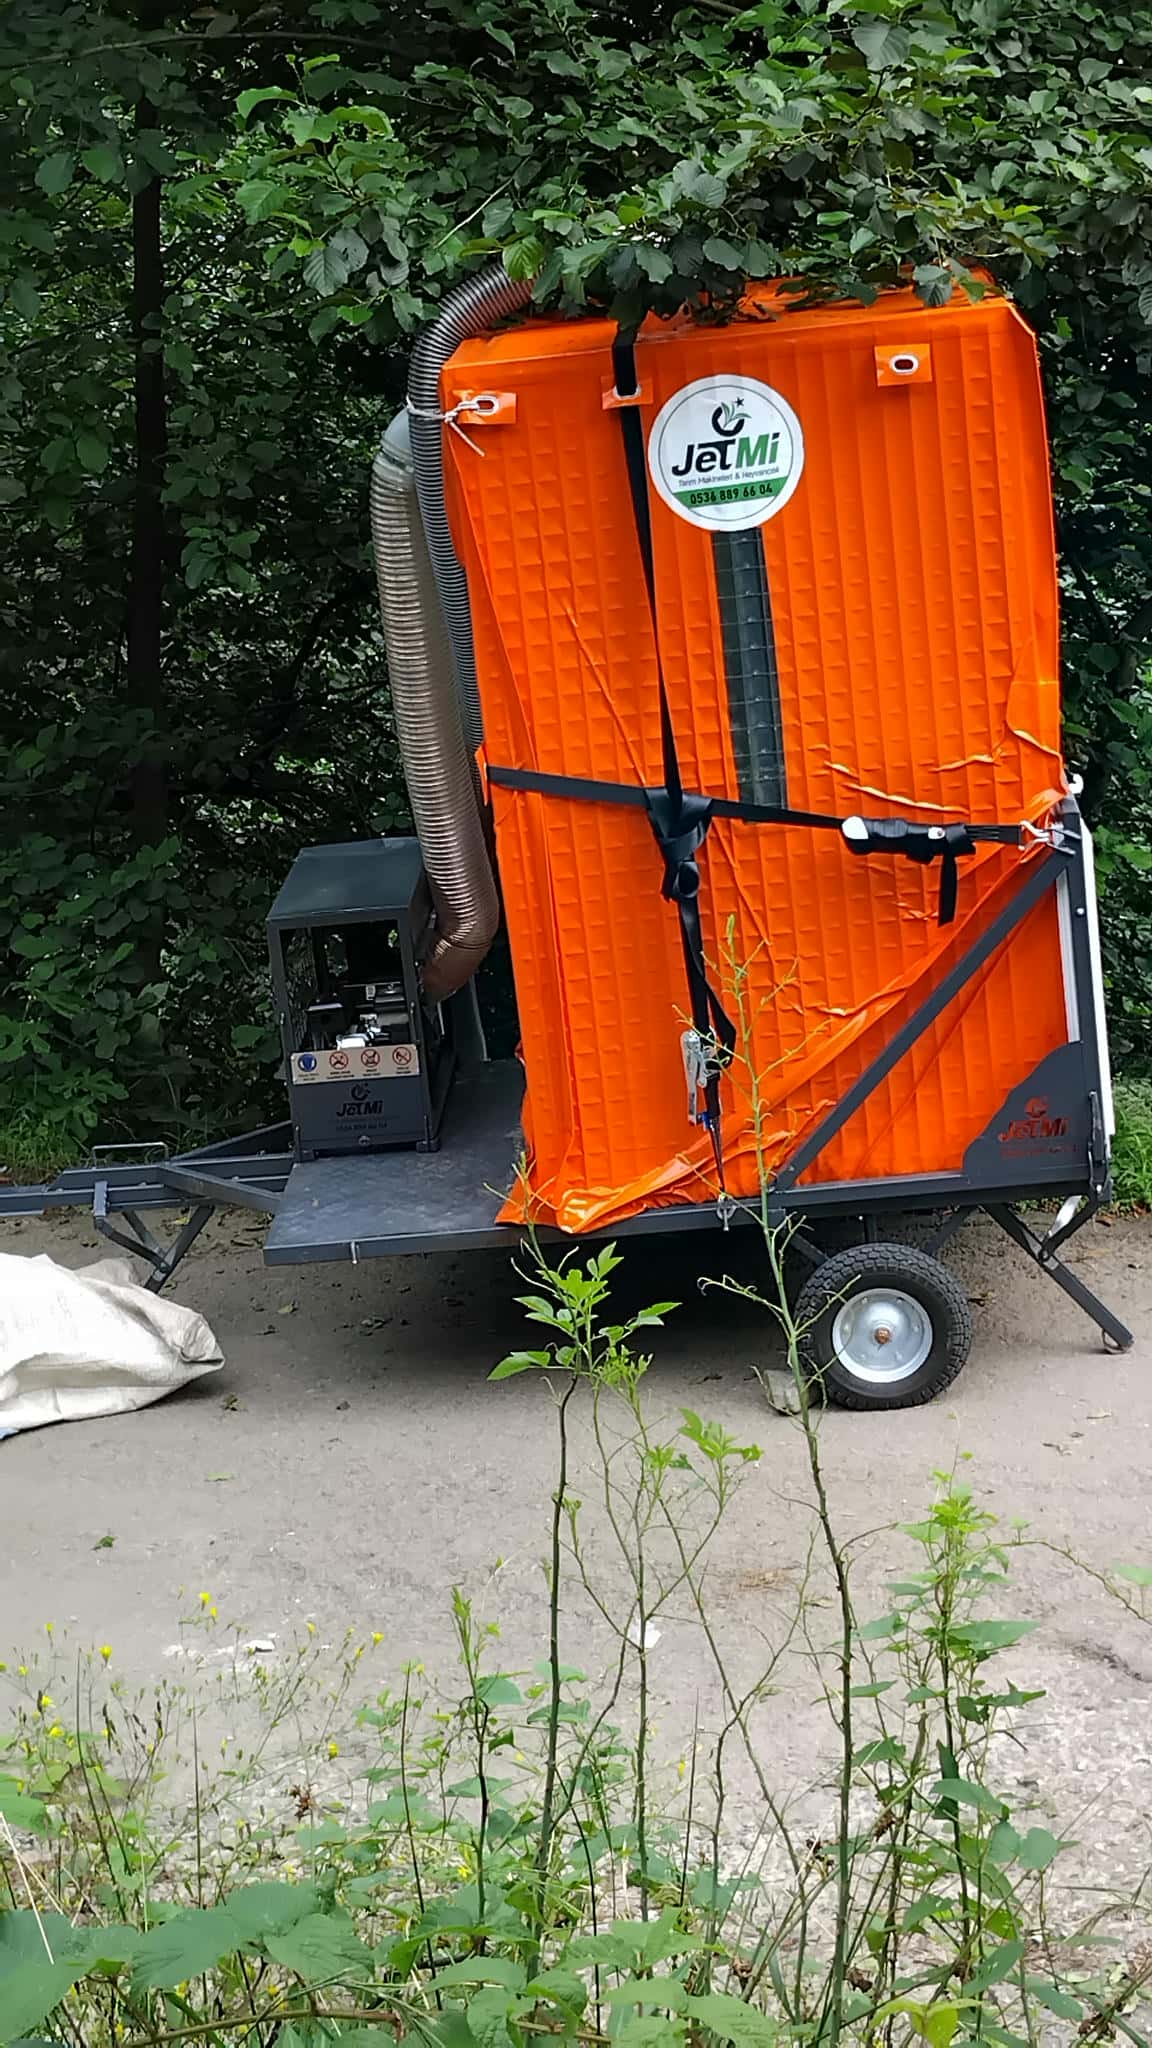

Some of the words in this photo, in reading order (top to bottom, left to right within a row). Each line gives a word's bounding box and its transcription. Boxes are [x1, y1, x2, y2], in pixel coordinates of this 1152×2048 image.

[735, 472, 741, 480] &
[690, 493, 716, 505] 0536
[720, 488, 739, 501] 889
[743, 485, 756, 497] 66
[759, 482, 773, 495] 04
